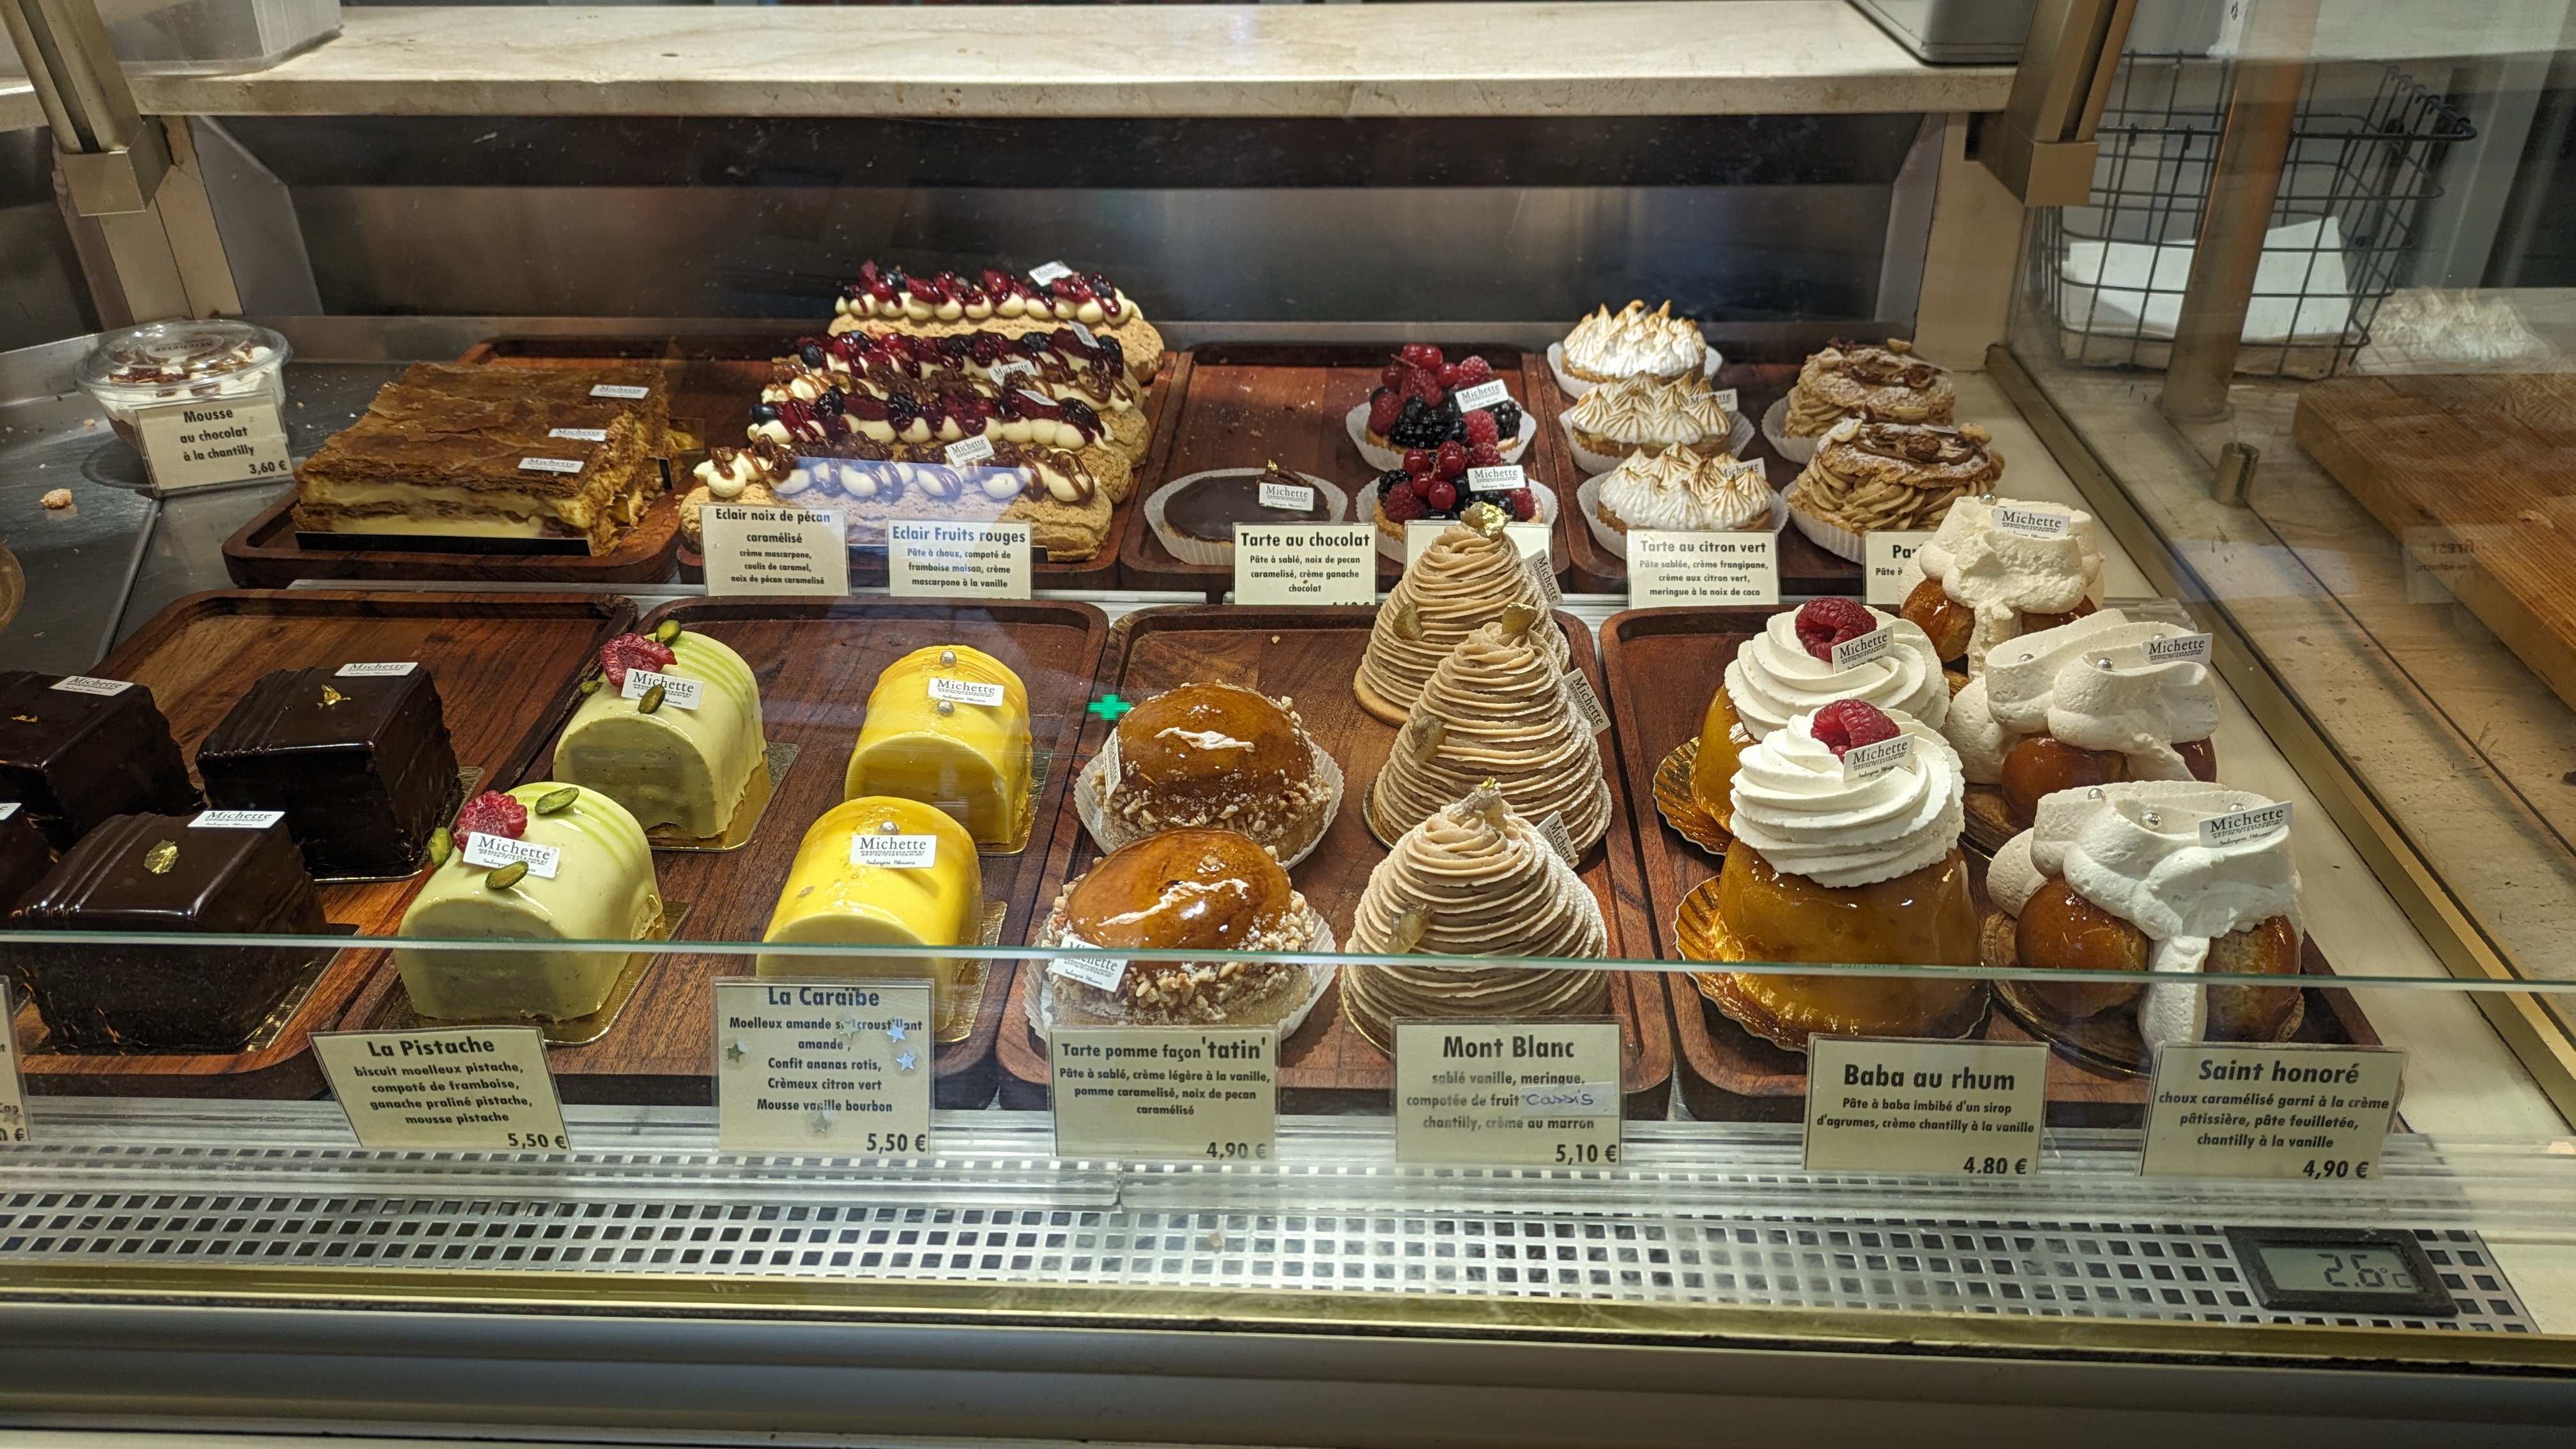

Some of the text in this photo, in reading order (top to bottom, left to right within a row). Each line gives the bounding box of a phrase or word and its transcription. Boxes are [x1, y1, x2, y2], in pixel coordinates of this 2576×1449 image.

[183, 410, 233, 423] Mousse
[180, 427, 247, 443] au chocolat
[183, 445, 254, 461] à la chantilly
[951, 440, 985, 454] Michette
[249, 460, 287, 475] 3,60 €
[1474, 469, 1517, 478] Michette
[1266, 486, 1308, 498] Michette
[716, 508, 830, 525] Eclair noix de pécan
[2001, 511, 2061, 528] Michette
[747, 533, 802, 543] caramélisé
[893, 526, 1025, 546] Eclair Fruits rouges
[1241, 532, 1370, 546] Tarte au chocolat
[1641, 540, 1766, 553] Tarte au citron vert
[1892, 544, 1923, 558] Par
[765, 551, 812, 560] mascarpone,
[908, 562, 1011, 574] framboise maison, crème
[1640, 560, 1658, 568] Pâte
[1661, 560, 1690, 569] sablée,
[1721, 560, 1768, 571] frangipane,
[1251, 569, 1360, 579] caramelisé, crème ganache
[1537, 556, 1558, 601] Michette
[1704, 574, 1728, 582] citron
[1731, 575, 1750, 583] vert,
[1289, 584, 1321, 592] chocolat
[1839, 633, 1887, 659] Michette
[2148, 640, 2204, 654] Michette
[69, 677, 122, 687] Michette
[632, 671, 694, 693] Michette
[936, 679, 995, 693] Michette
[1572, 675, 1604, 726] Michette
[1852, 741, 1908, 765] Michette
[2209, 809, 2283, 833] Michette
[477, 836, 550, 860] Michette
[859, 837, 926, 849] Michette
[768, 987, 880, 1007] La Caraïbe
[730, 1017, 782, 1029] Moelleux
[786, 1018, 831, 1030] amande
[367, 1036, 495, 1057] La Pistache
[1062, 1043, 1100, 1057] Tarte
[1106, 1046, 1158, 1060] pomme
[1162, 1044, 1200, 1062] façon
[1443, 1034, 1574, 1058] Mont Blanc
[354, 1062, 524, 1077] biscuit moelleux pistache,
[768, 1057, 882, 1072] Confit ananas rotis,
[2198, 1059, 2360, 1084] Saint honoré
[768, 1077, 882, 1091] Crèmeux citron vert
[1432, 1071, 1466, 1084] sablé
[1469, 1071, 1516, 1085] vanille,
[1844, 1064, 2014, 1091] Baba au rhum
[372, 1078, 519, 1095] compoté de framboise,
[1075, 1087, 1256, 1101] pomme caramelisé, noix de pecan
[757, 1098, 893, 1112] Mousse vanille bourbon
[1407, 1094, 1468, 1108] compotée
[1471, 1094, 1486, 1106] de
[1843, 1098, 2011, 1116] Pâte à baba imbibé d'un sirop
[2159, 1092, 2389, 1110] choux caramélisé garni à la crème
[1137, 1105, 1194, 1116] caramélisé
[405, 1113, 509, 1126] mousse pistache
[1423, 1116, 1594, 1131] chantilly, crème au marron
[1817, 1114, 2034, 1133] d'agrumes, crème chantilly à la vanille
[2180, 1113, 2359, 1130] pâtissière, pâte feuilletée,
[507, 1133, 567, 1149] 5,50 €
[866, 1133, 926, 1154] 5,50 €
[1206, 1141, 1267, 1160] 4,90 €
[1556, 1144, 1617, 1165] 5,10 €
[2014, 1158, 2027, 1175] €
[2303, 1160, 2369, 1180] 4,90 €
